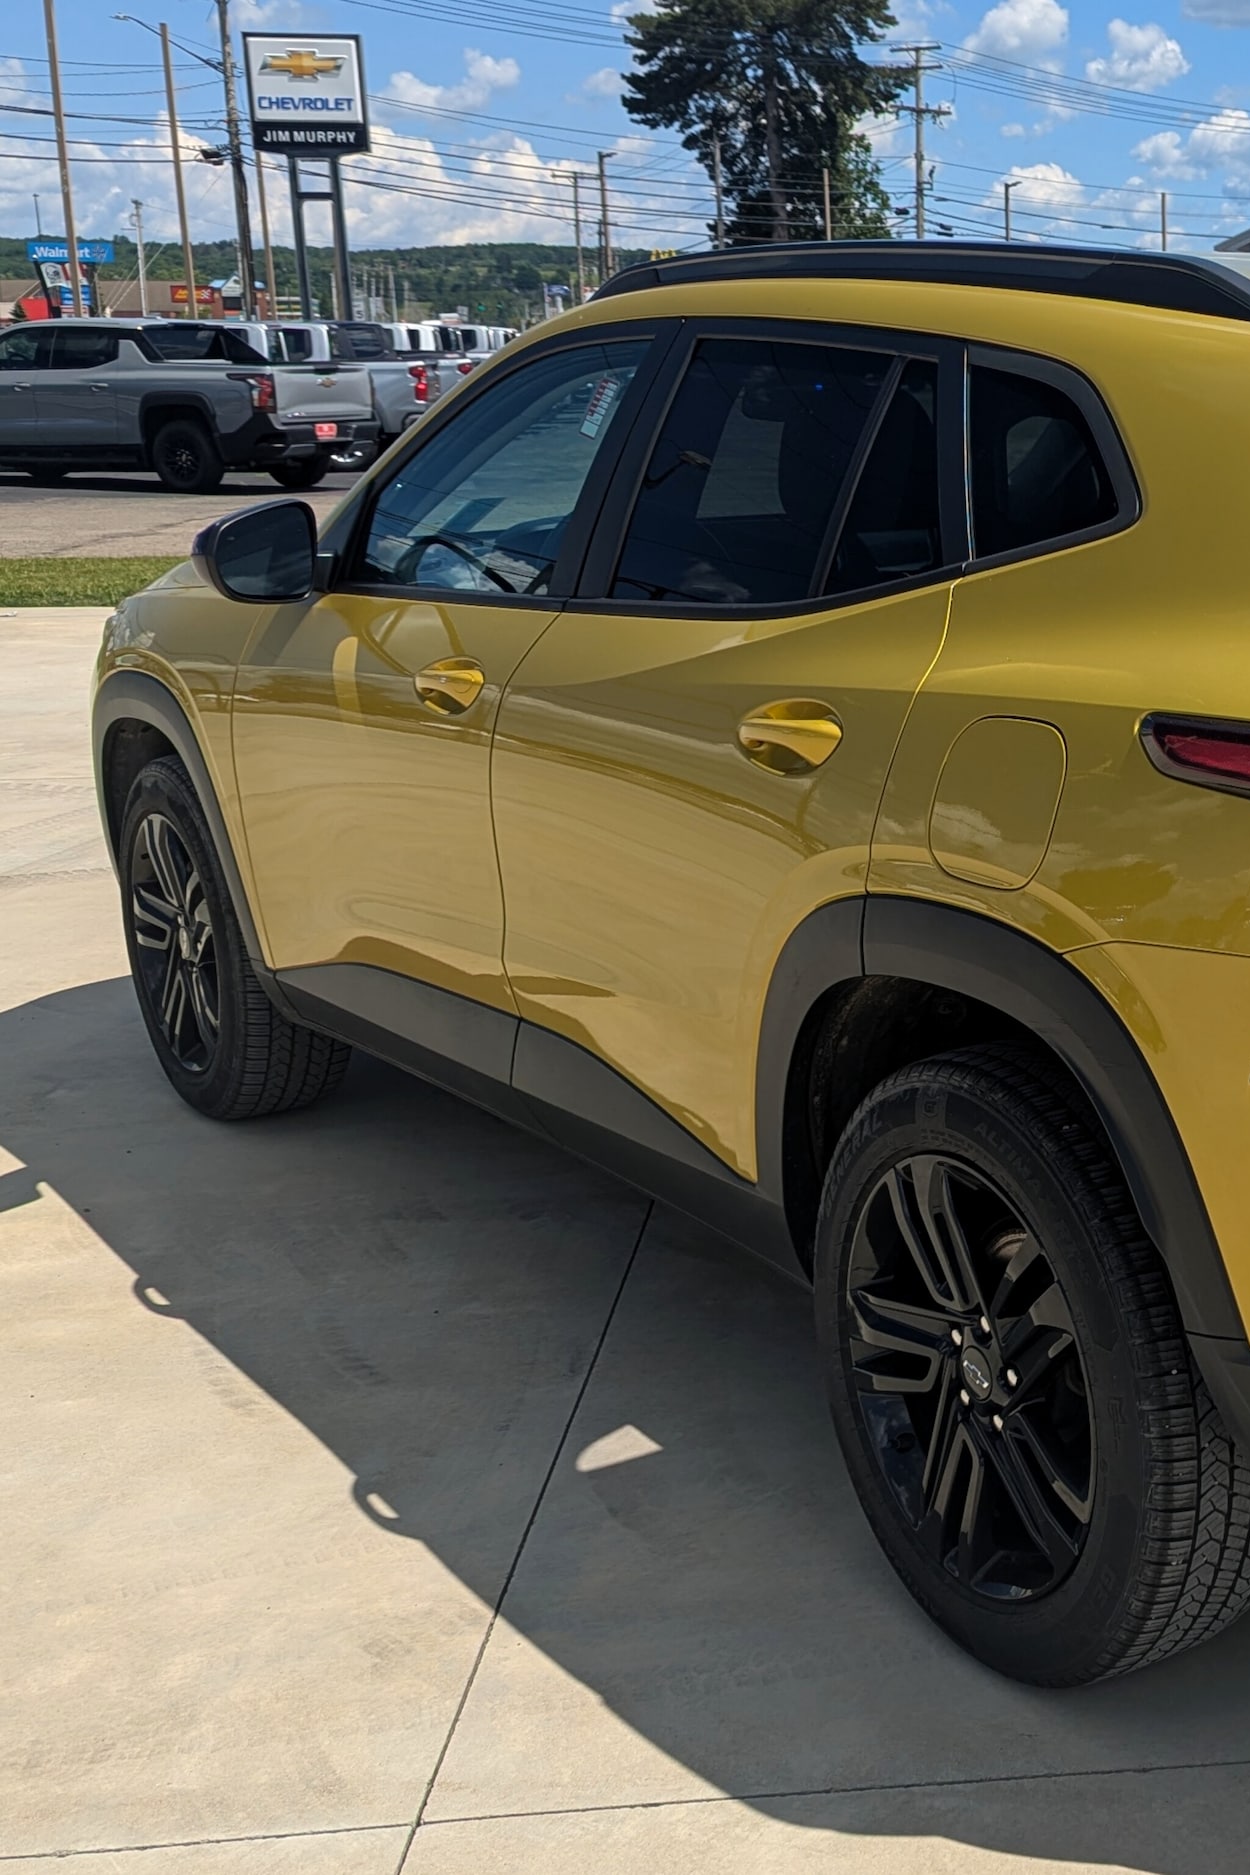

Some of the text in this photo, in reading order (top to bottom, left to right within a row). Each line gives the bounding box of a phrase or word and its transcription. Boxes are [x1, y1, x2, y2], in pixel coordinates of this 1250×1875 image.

[257, 96, 353, 111] CHEVROLET
[263, 129, 356, 143] JIM MURPHY
[35, 246, 90, 257] Walmrt
